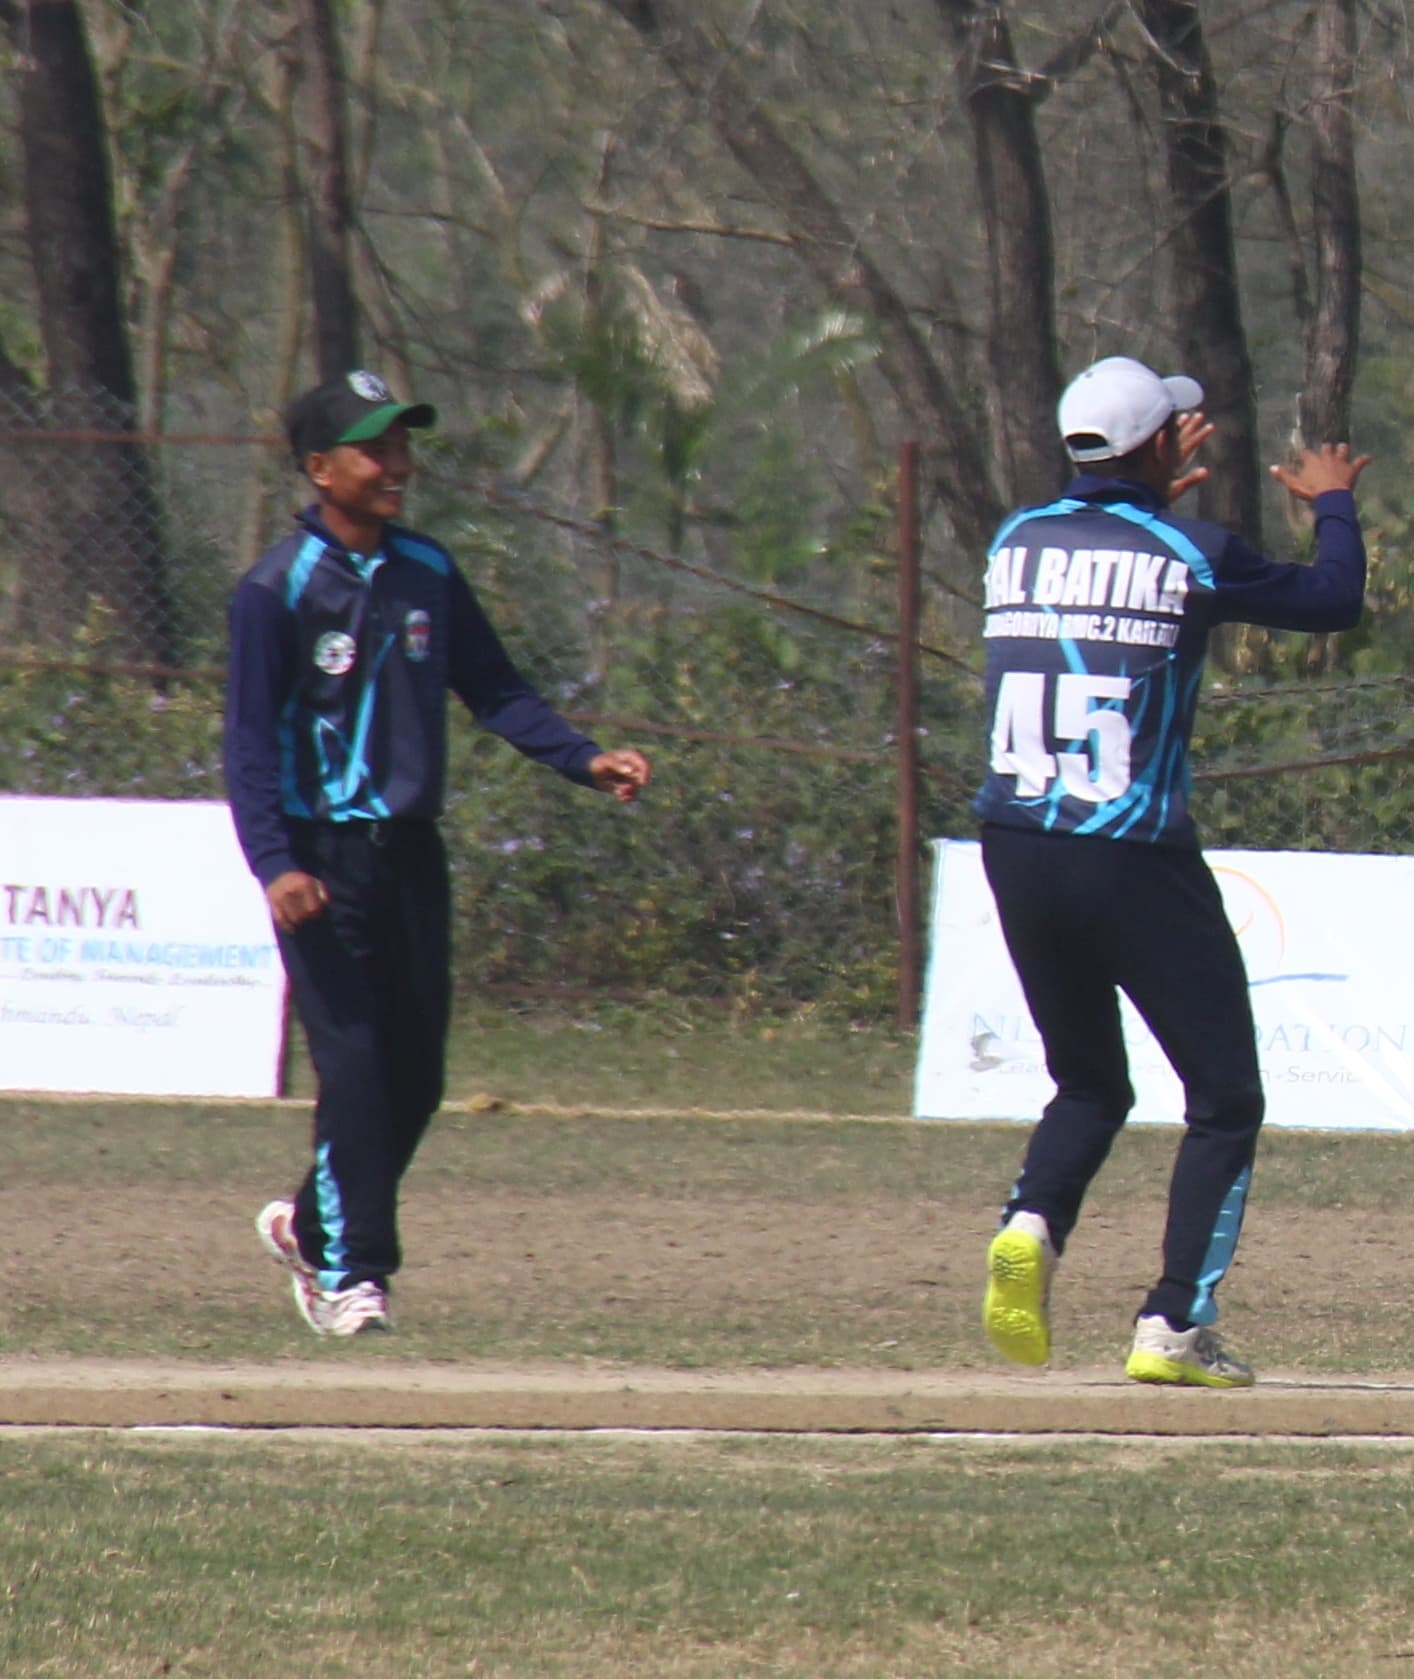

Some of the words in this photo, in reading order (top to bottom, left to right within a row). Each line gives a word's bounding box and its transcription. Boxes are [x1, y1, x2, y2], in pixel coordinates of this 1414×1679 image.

[983, 547, 1028, 609] AL
[1032, 547, 1188, 615] BATIKA
[990, 672, 1132, 803] 45
[3, 884, 141, 930] TANYA
[79, 939, 278, 969] MANAGEMENT
